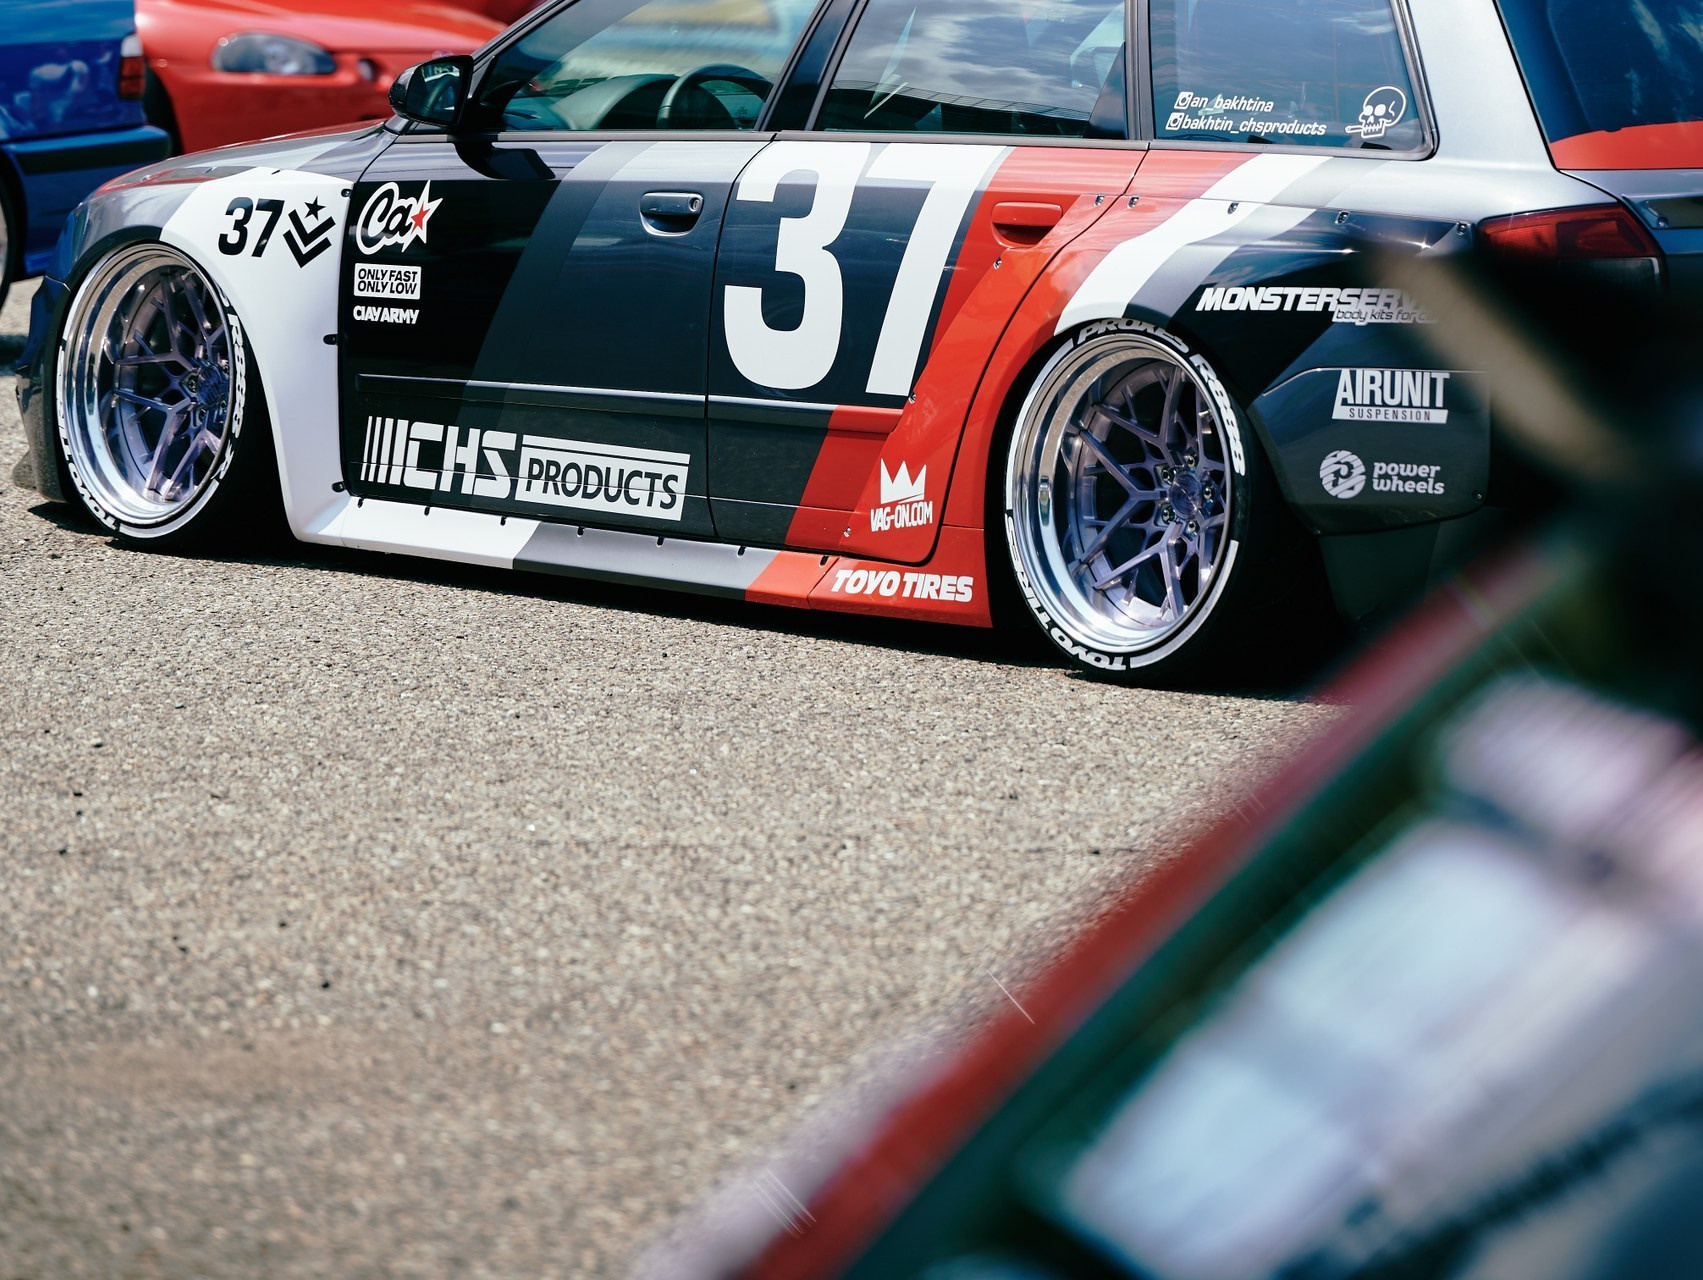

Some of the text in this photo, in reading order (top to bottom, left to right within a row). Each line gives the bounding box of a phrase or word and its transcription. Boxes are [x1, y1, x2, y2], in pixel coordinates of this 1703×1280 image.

[1190, 94, 1274, 113] an_bakhtina
[1182, 115, 1327, 136] bakhtin_chsproducts
[218, 197, 285, 258] 37
[358, 268, 418, 282] ONLY FAST
[724, 140, 1007, 397] 37
[358, 280, 417, 295] ONLY LOW
[1195, 287, 1426, 312] MONSTERSERV
[1336, 309, 1367, 322] body
[1370, 309, 1394, 320] kits
[1334, 369, 1450, 408] AIRUNIT
[1349, 407, 1431, 421] SUSPENSION
[1373, 462, 1441, 478] power
[526, 457, 679, 510] PRODUCTS
[1372, 476, 1445, 495] wheels
[870, 501, 933, 532] VAG-ON.COM
[831, 570, 974, 602] TOYO TIRES
[1050, 627, 1127, 670] TOYO
